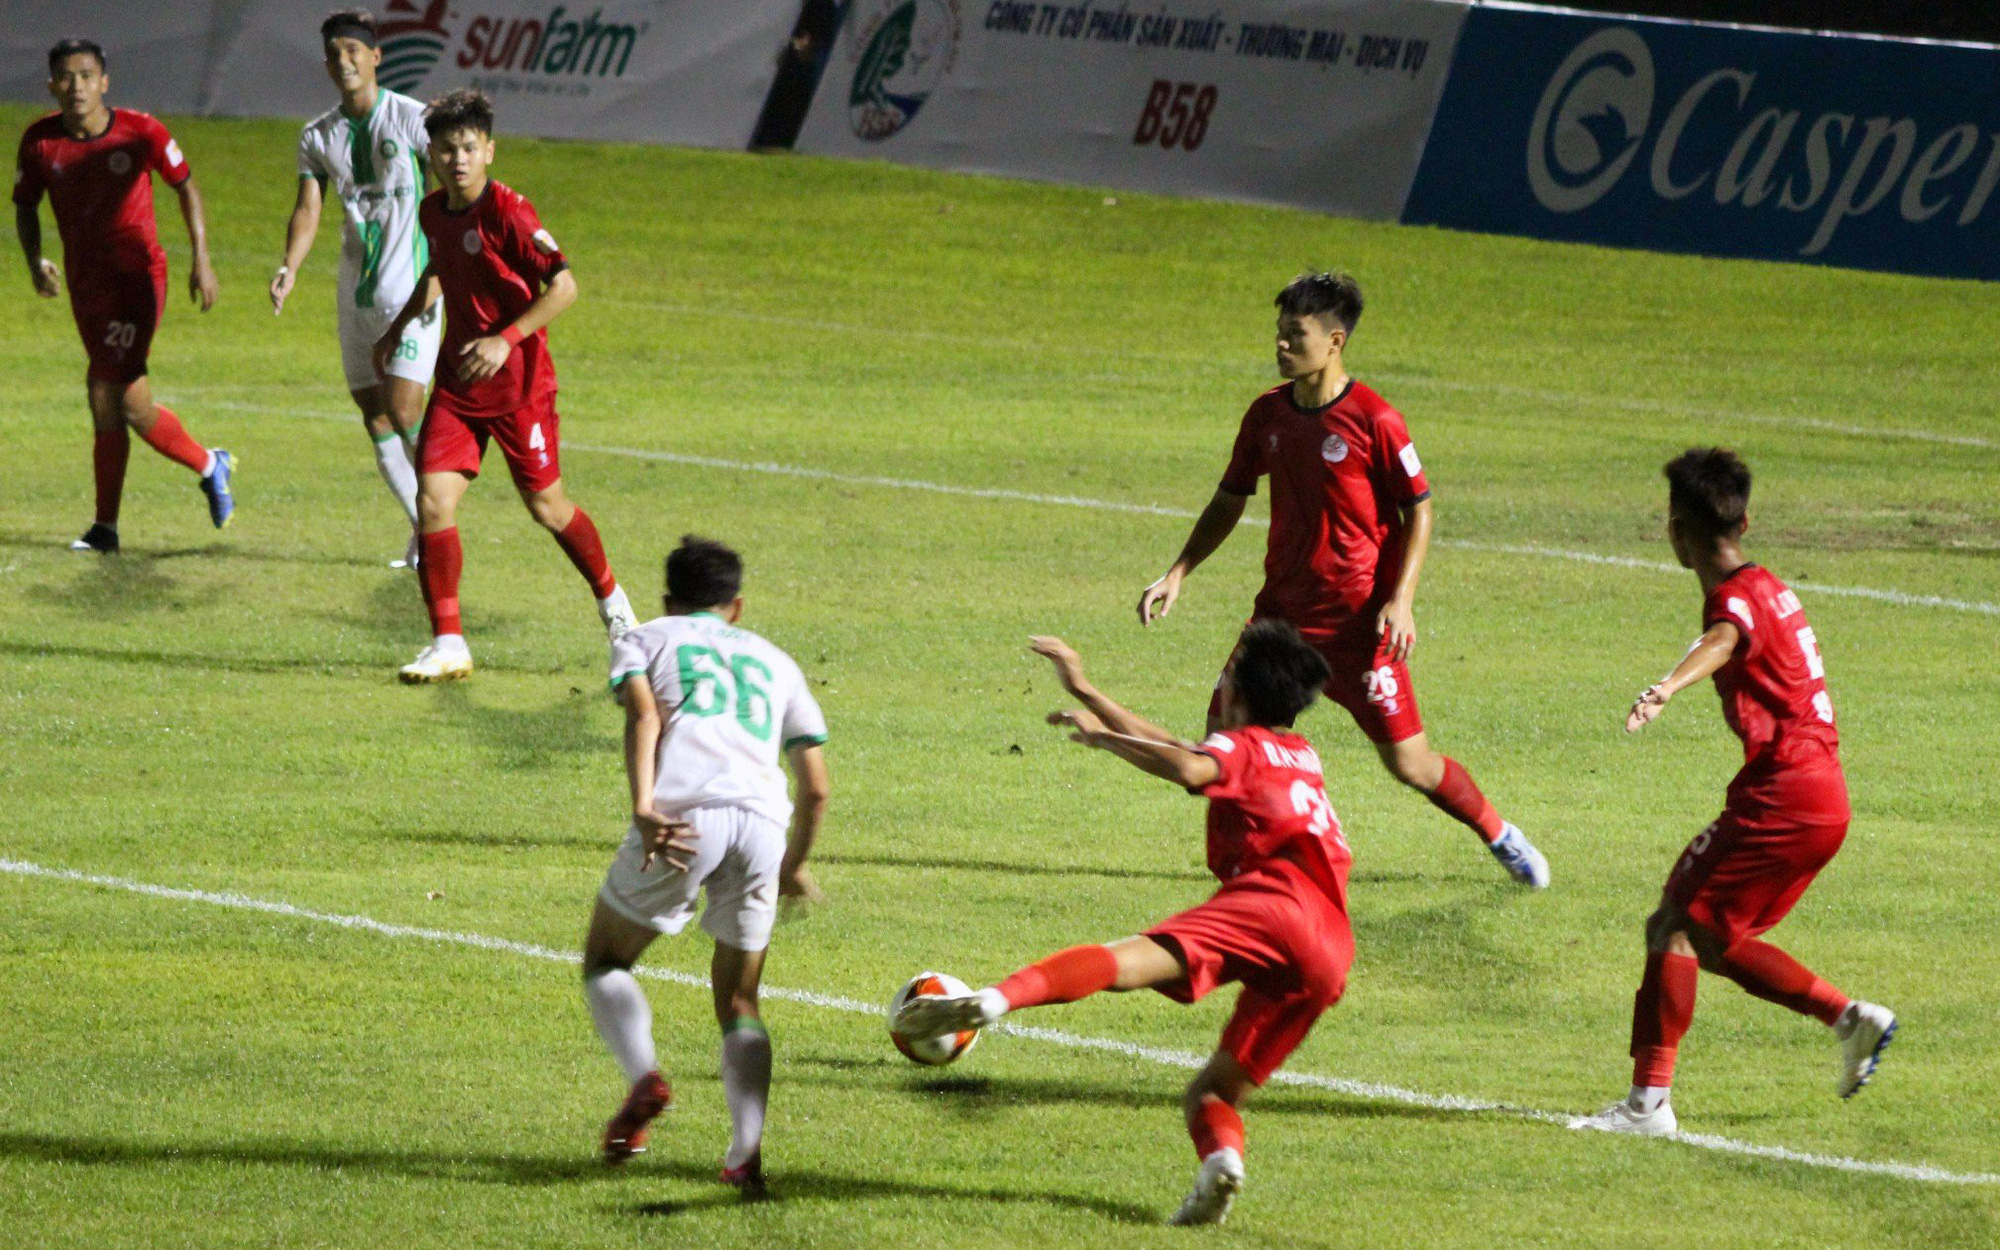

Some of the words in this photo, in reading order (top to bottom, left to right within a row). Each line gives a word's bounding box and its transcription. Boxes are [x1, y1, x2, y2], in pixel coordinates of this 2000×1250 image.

[456, 6, 637, 77] sunfarm
[1133, 80, 1219, 151] B58
[1650, 67, 2000, 255] Casper
[104, 320, 137, 350] 20
[529, 422, 546, 452] 4
[676, 643, 773, 742] 66
[1361, 665, 1398, 703] 26
